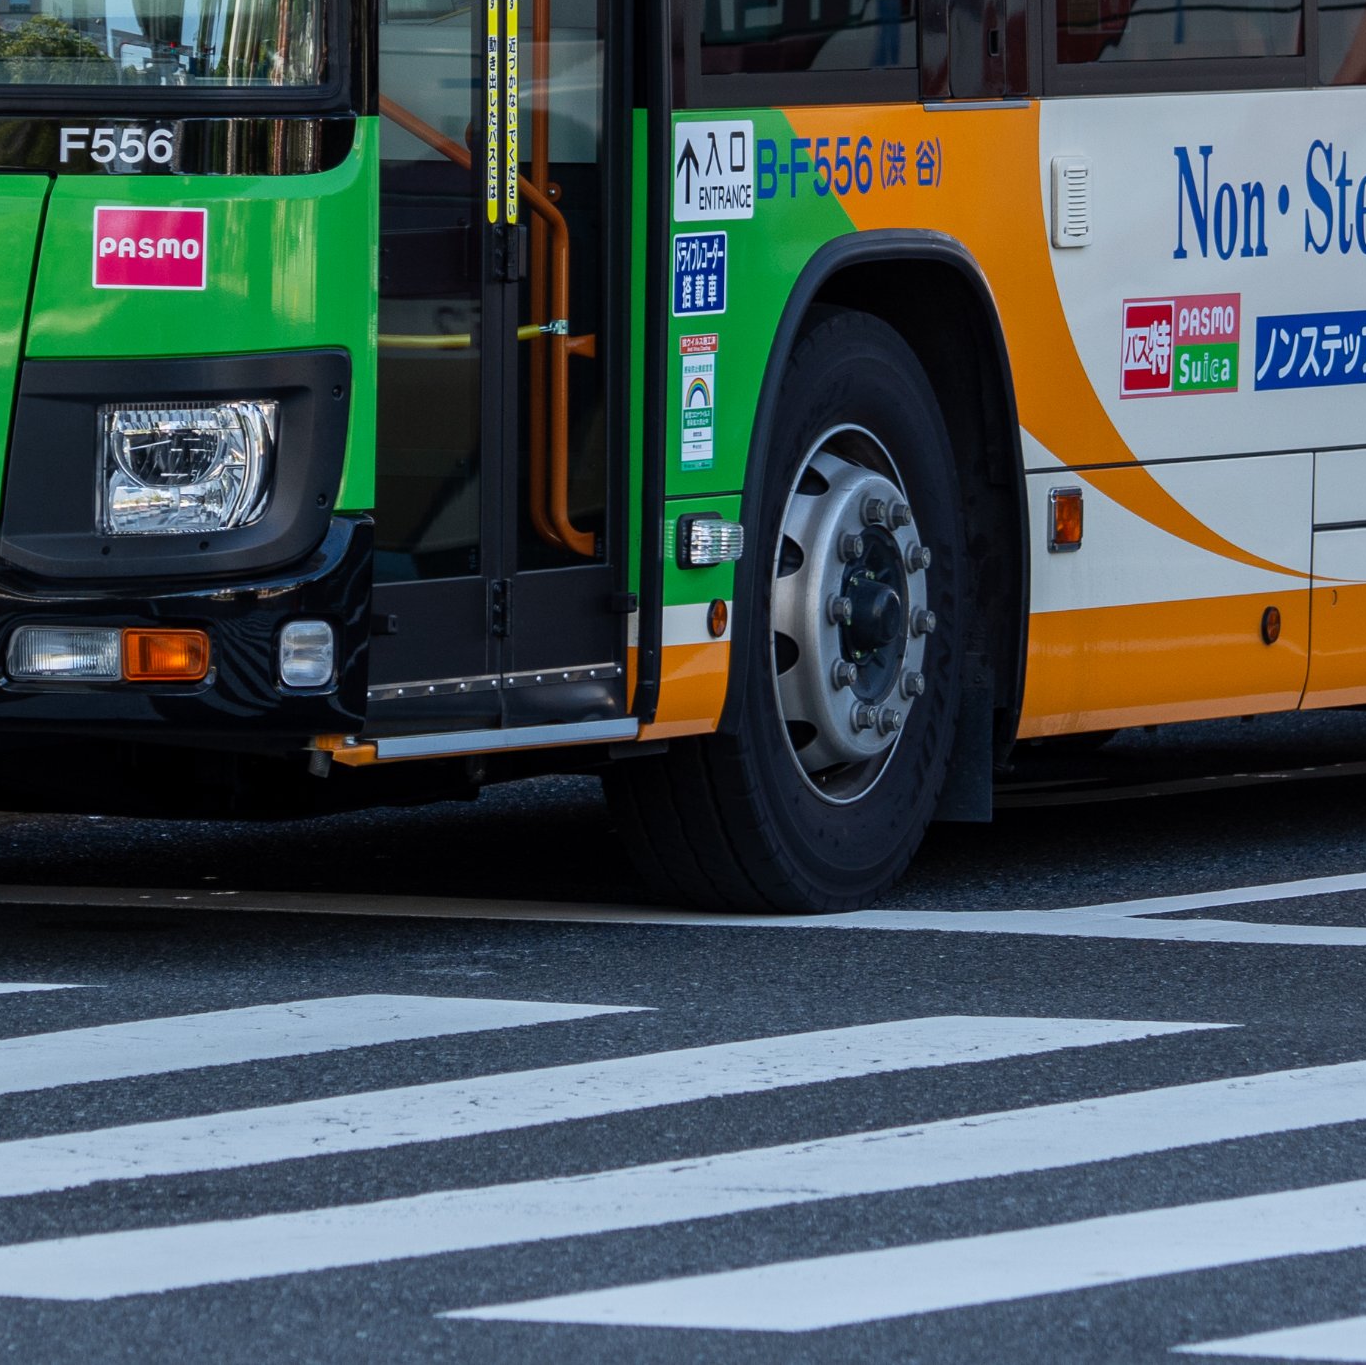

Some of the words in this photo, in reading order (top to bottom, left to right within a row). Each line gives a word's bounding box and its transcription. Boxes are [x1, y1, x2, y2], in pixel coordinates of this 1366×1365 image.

[59, 127, 175, 165] F556
[705, 131, 746, 177] 入口
[756, 135, 874, 200] B-F556
[698, 184, 752, 211] ENTRANCE
[98, 236, 200, 261] PASMO
[676, 238, 725, 273] ドライブレコーダー
[682, 274, 718, 309] 搭載車
[1178, 306, 1235, 337] PASMO
[1178, 352, 1230, 384] Suica
